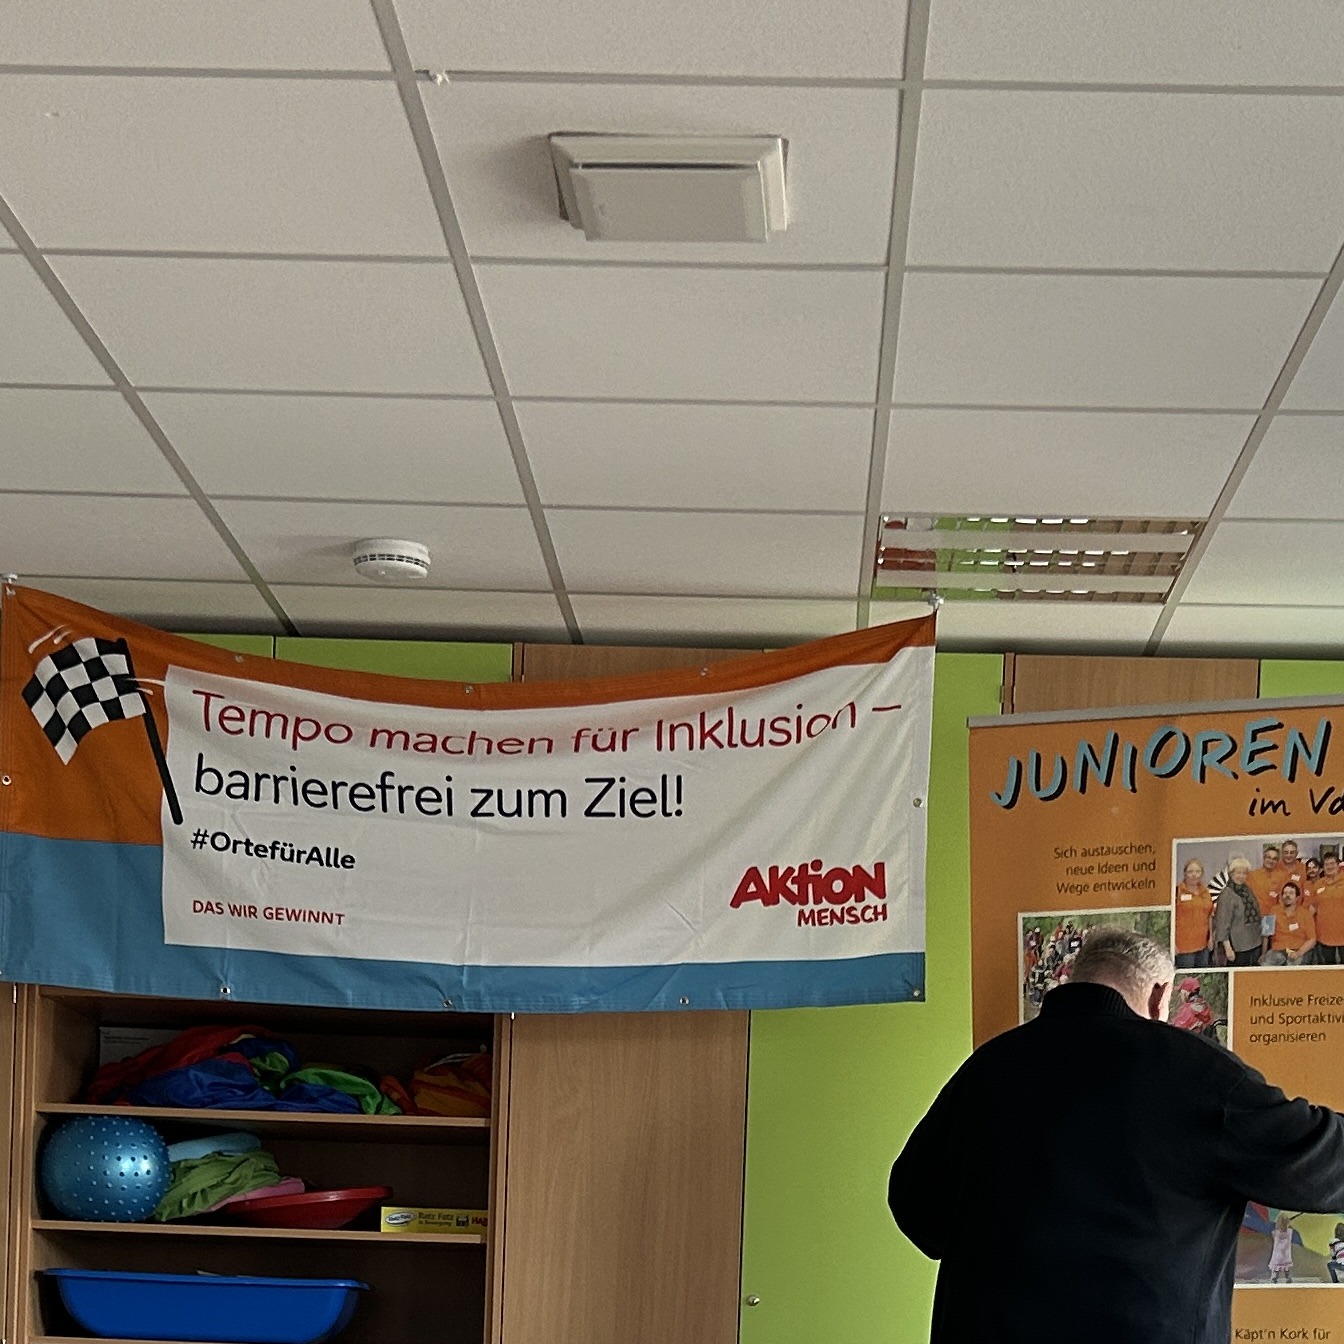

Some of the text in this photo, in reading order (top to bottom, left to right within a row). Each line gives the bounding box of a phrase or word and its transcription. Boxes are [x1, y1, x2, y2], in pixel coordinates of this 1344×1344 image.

[192, 689, 354, 752] Tempo
[369, 727, 553, 756] machen
[573, 726, 640, 753] für
[656, 701, 857, 752] Inklusion
[989, 716, 1332, 811] JUNIOREN
[194, 752, 684, 819] barrierefrei zum Ziel!
[1249, 788, 1291, 818] im
[190, 827, 356, 870] #OrtefürAlle
[1053, 842, 1156, 859] Sich austauschen,
[1066, 858, 1156, 876] neue Ideen und
[1056, 877, 1156, 896] Wege entwickeln
[192, 899, 346, 926] DAS WIR GEWINNT
[797, 903, 888, 928] MENSCH
[1250, 994, 1304, 1007] Inklusive
[1250, 1012, 1274, 1025] und
[1249, 1029, 1326, 1045] organisieren
[1280, 1328, 1309, 1340] Kork
[1313, 1327, 1331, 1340] für
